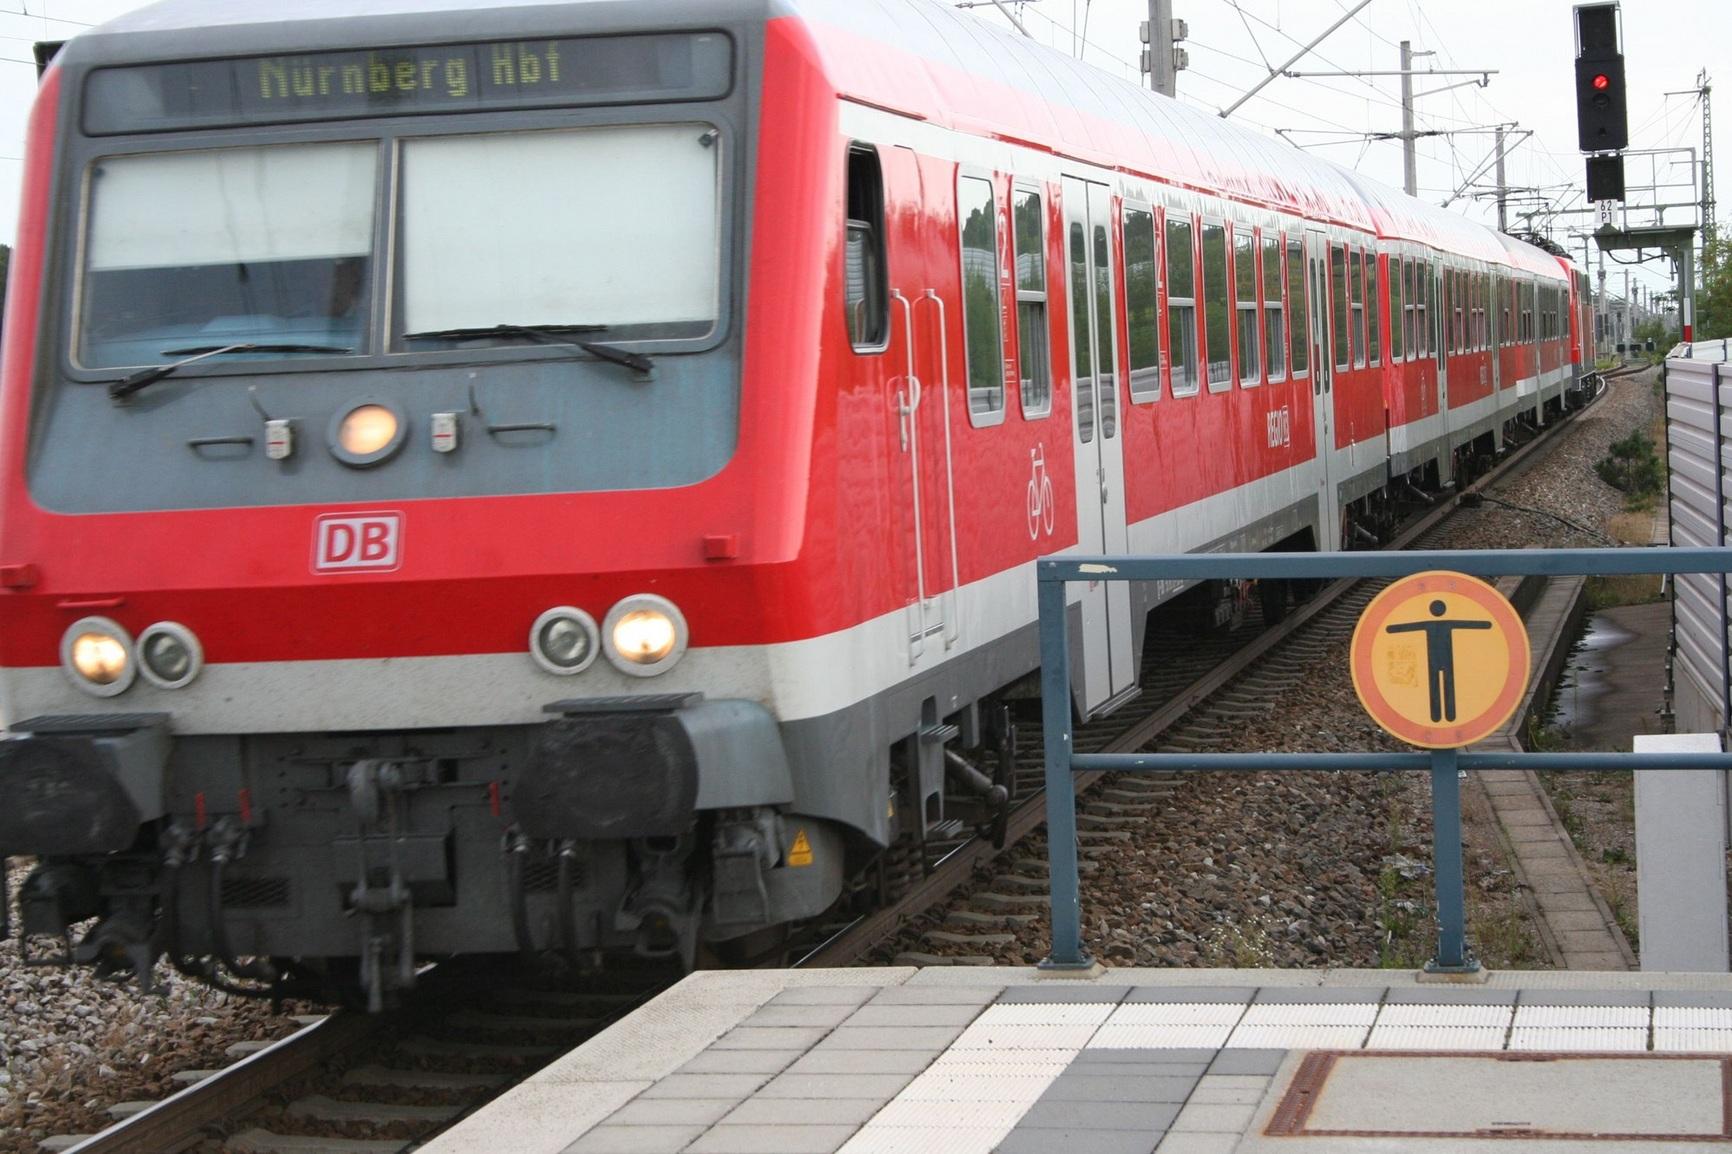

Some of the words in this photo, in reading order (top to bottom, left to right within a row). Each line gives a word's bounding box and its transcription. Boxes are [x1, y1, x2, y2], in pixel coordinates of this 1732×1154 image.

[1600, 200, 1612, 211] 62
[1601, 211, 1612, 223] P1
[999, 212, 1009, 278] 2
[325, 522, 390, 563] DB
